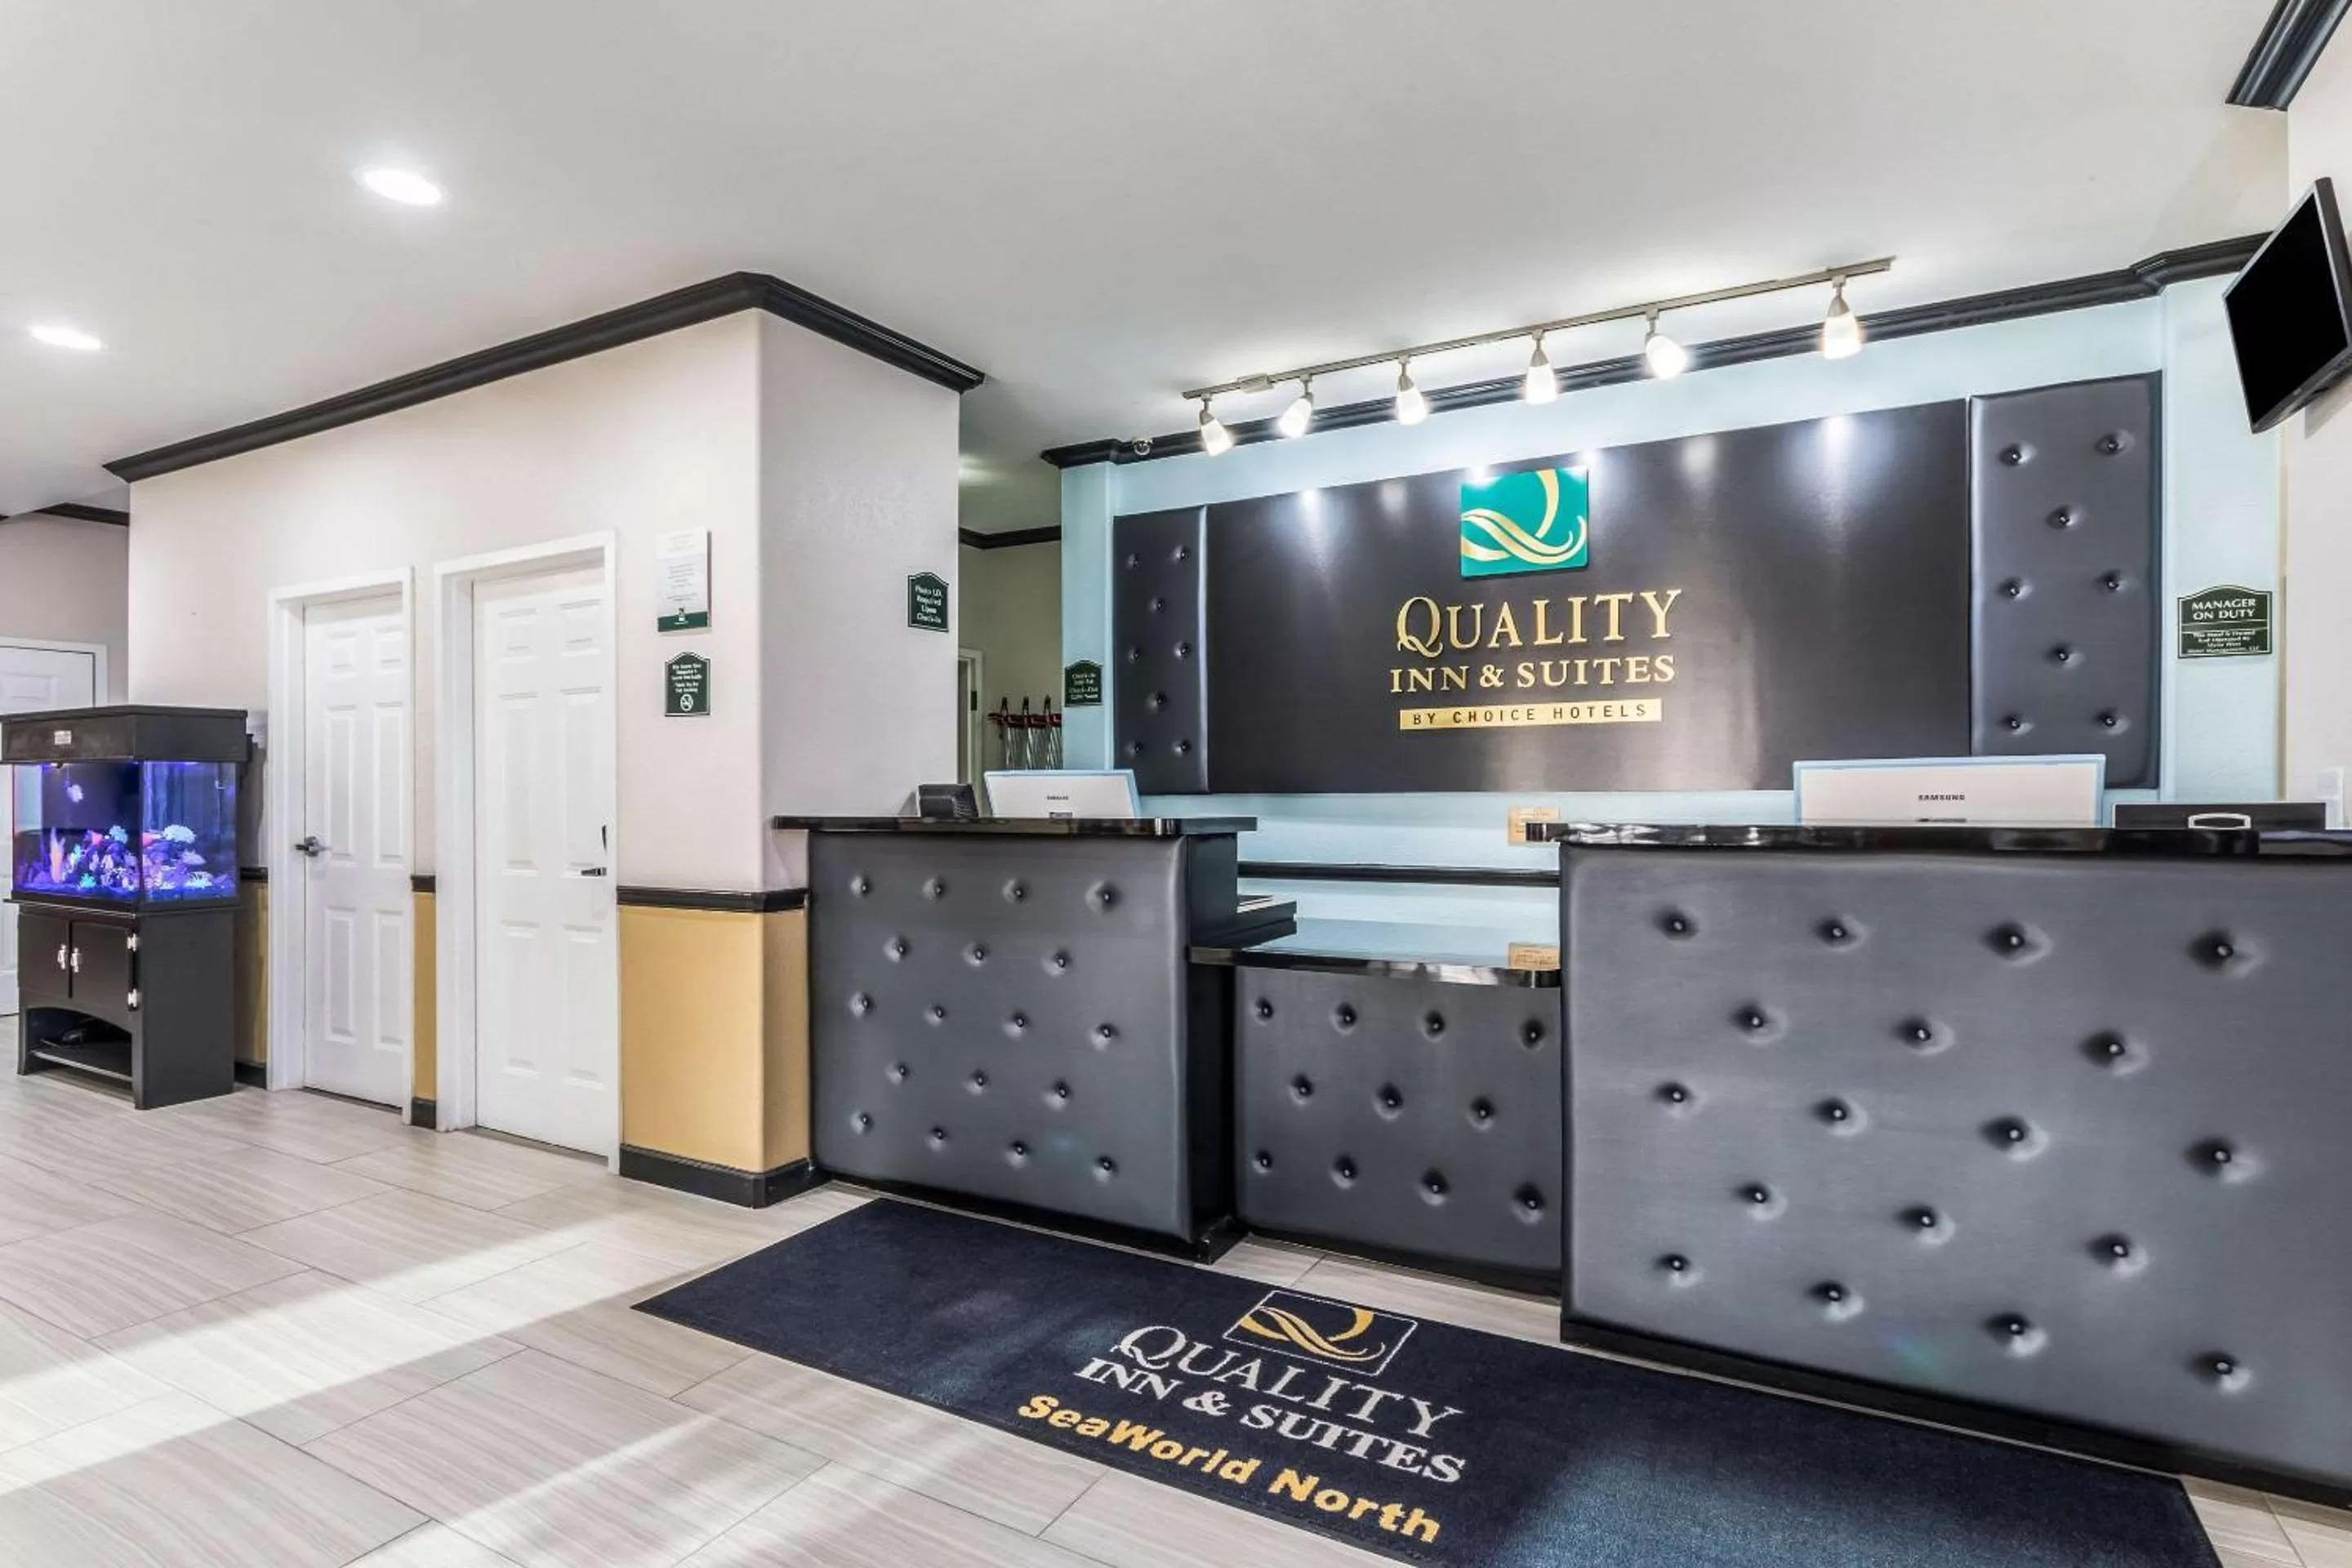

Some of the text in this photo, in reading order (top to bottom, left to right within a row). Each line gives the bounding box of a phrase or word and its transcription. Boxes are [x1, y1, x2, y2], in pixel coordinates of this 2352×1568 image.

[1396, 589, 1682, 658] QUALITY
[2192, 599, 2256, 610] MANAGER
[2193, 608, 2255, 621] ON DUTY
[1390, 654, 1675, 693] INN & SUITES
[1413, 705, 1647, 725] BY CHOICE HOTELS
[1111, 1325, 1464, 1438] QUALITY
[1074, 1357, 1467, 1483] INN & SUITES
[1018, 1393, 1442, 1544] SeaWorld North
